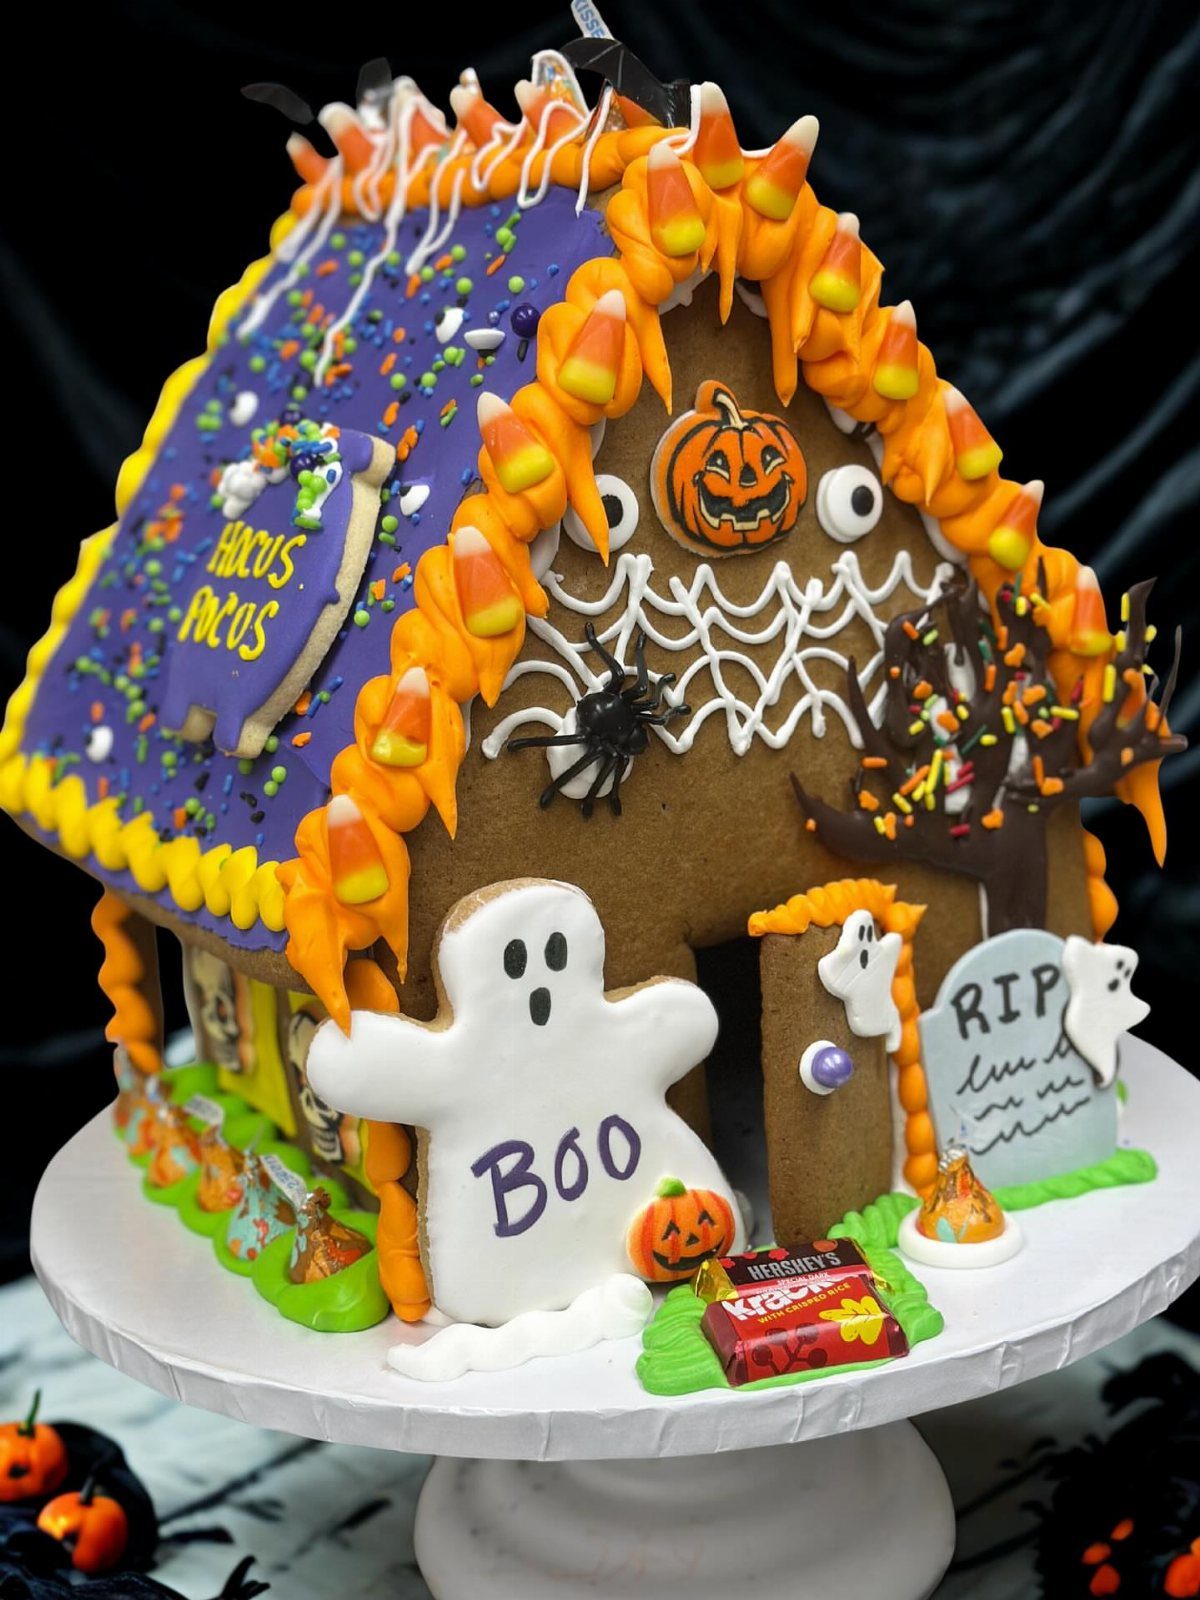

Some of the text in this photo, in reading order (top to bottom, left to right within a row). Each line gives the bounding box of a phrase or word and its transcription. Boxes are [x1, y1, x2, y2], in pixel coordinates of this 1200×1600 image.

[206, 521, 307, 588] HOCUS
[177, 585, 280, 661] POCUS
[951, 963, 1060, 1040] RIP
[470, 1114, 641, 1237] BOO
[747, 1252, 841, 1280] HERSHEY'S
[758, 1282, 851, 1323] WITH CRISPED RICE
